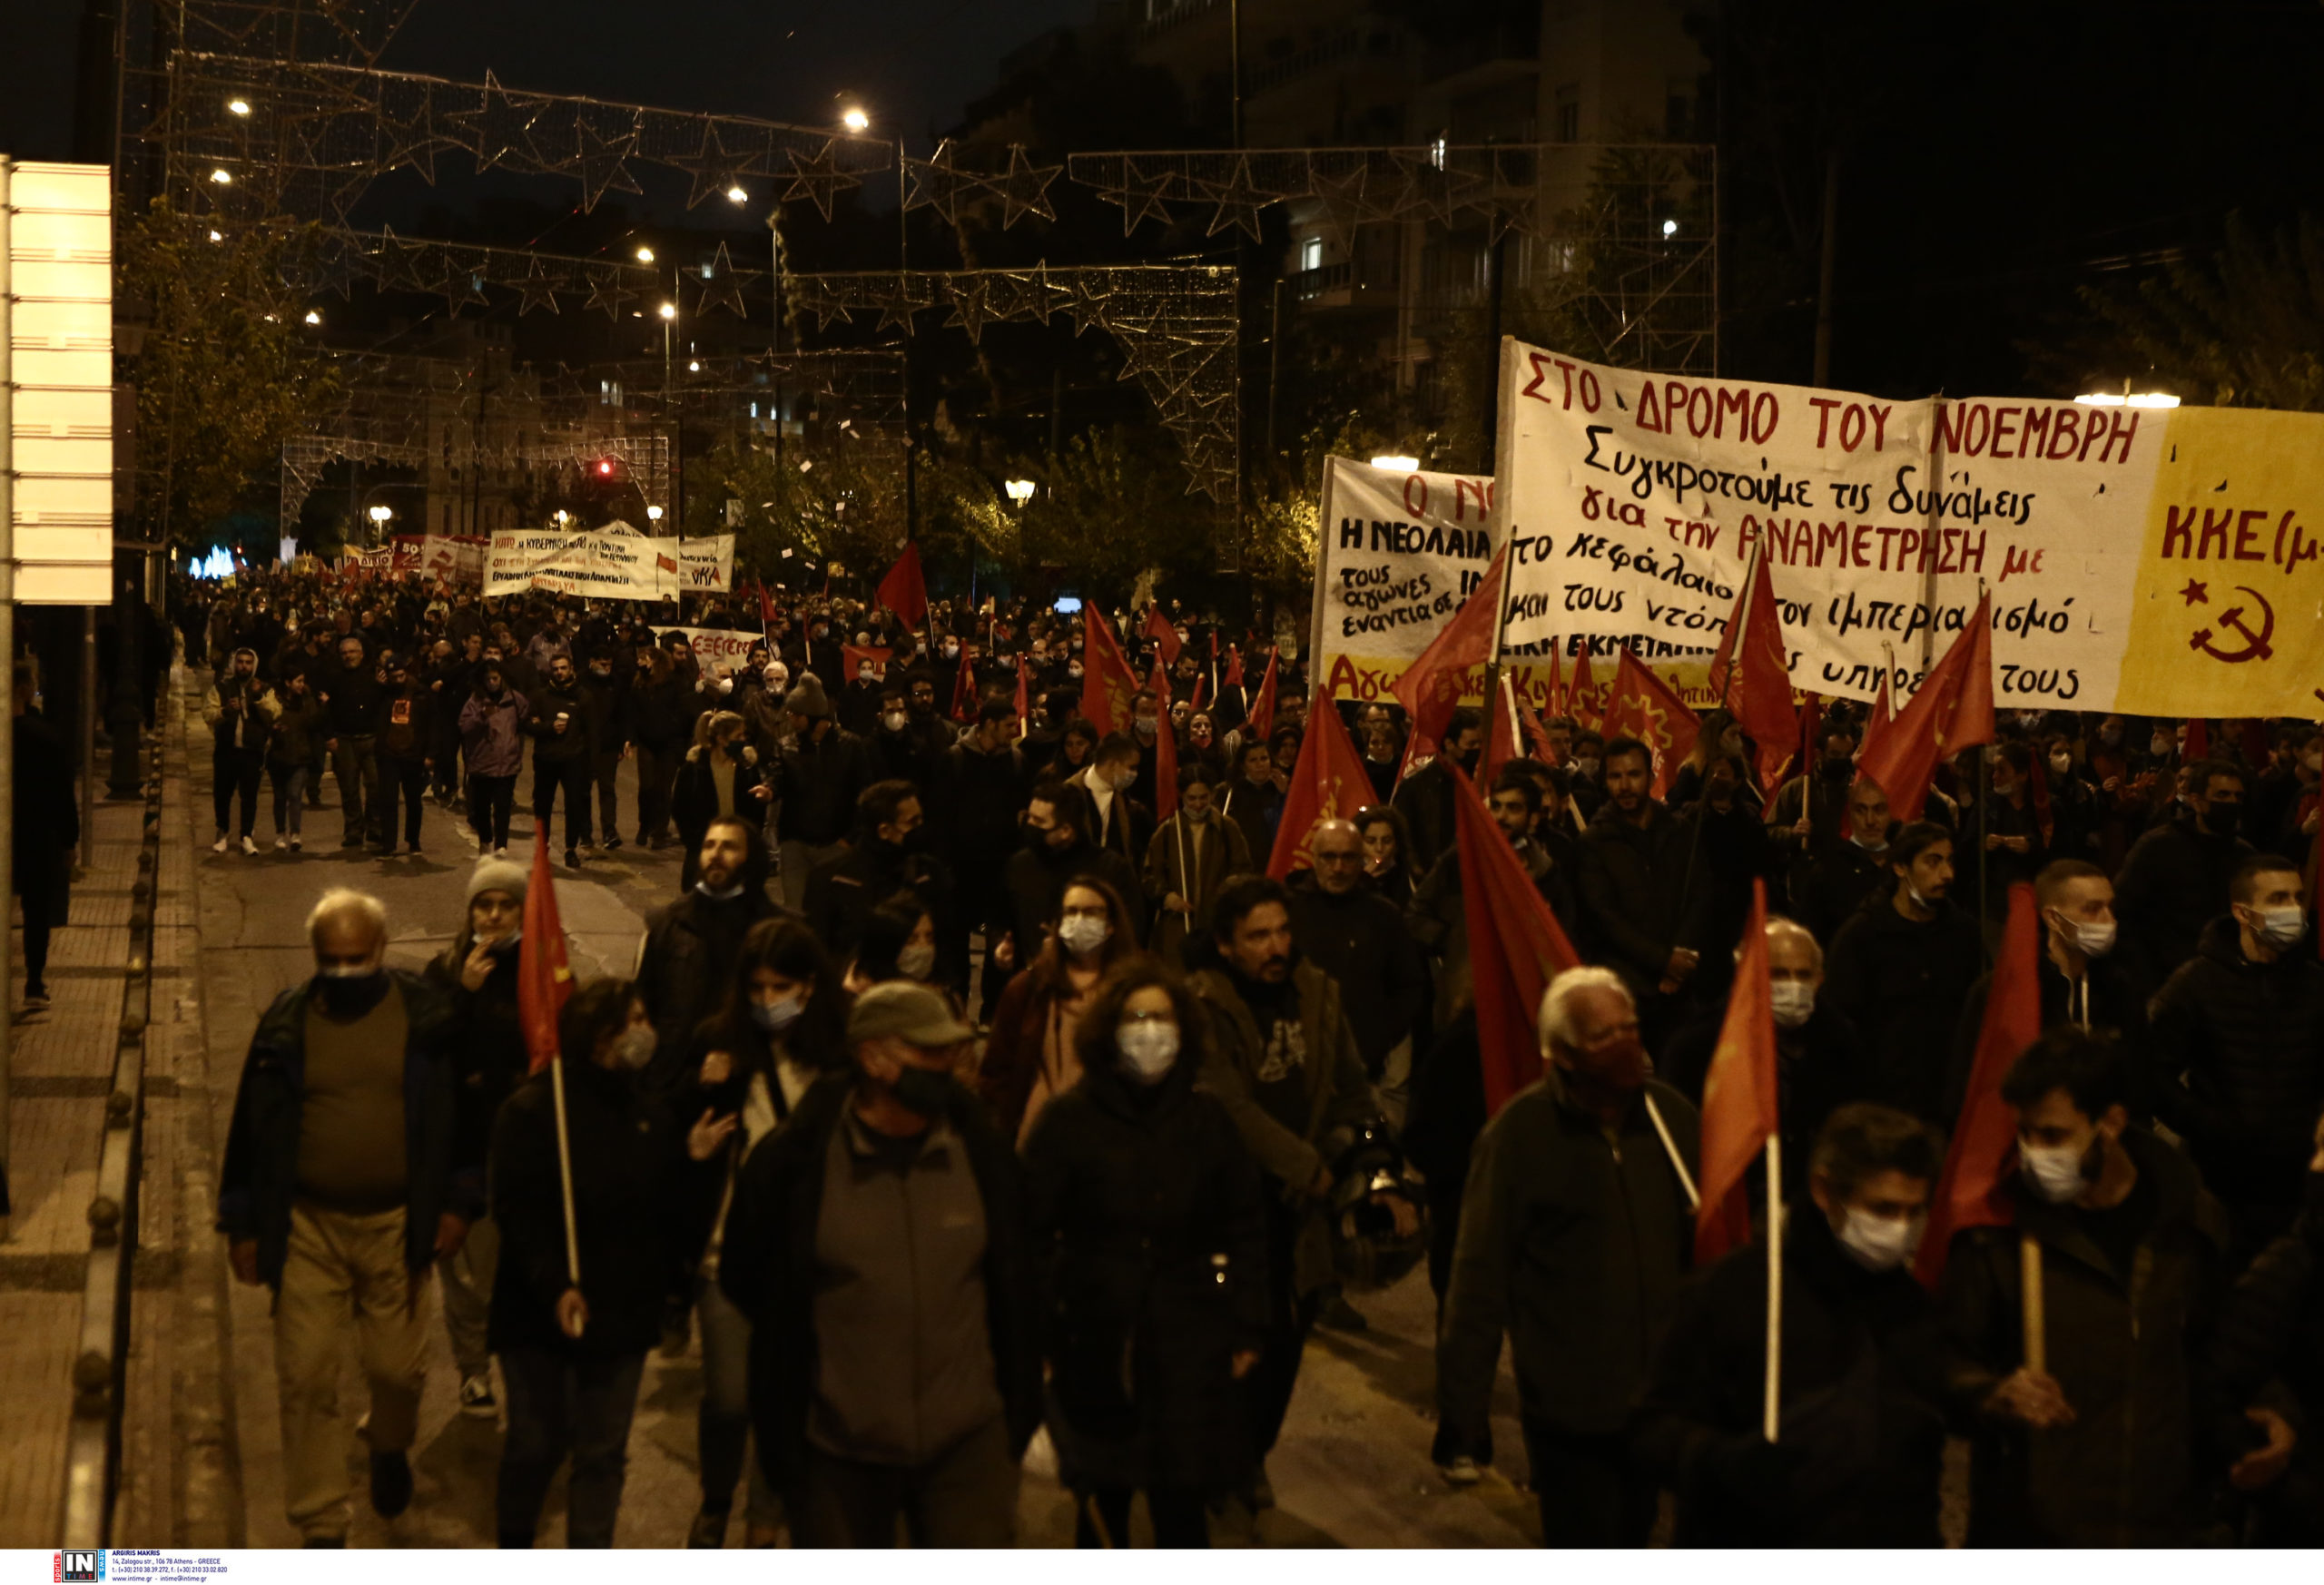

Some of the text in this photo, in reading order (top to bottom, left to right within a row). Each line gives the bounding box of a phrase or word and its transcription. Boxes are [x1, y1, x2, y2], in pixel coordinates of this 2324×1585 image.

[1522, 352, 2140, 464] ΣΤΟ ΔΡΟΜΟ ΤΟΥ ΝΟΕΜΒΡΗ
[1584, 425, 2036, 526] Συγκροτούμε τις δυνάμεις
[1339, 564, 1391, 589] τους
[1340, 517, 1491, 560] Η ΝΕΟΛΑΙΑ
[1581, 485, 2045, 583] για την ΑΝΑΜΕΤΡΗΣΗ με
[1512, 536, 1552, 564] το
[1566, 533, 1734, 600] κεφάλαιο
[1827, 591, 2075, 644] ιμπεριαισμό
[1504, 593, 1549, 625] και
[1564, 584, 1627, 613] τους
[2000, 664, 2080, 700] τους
